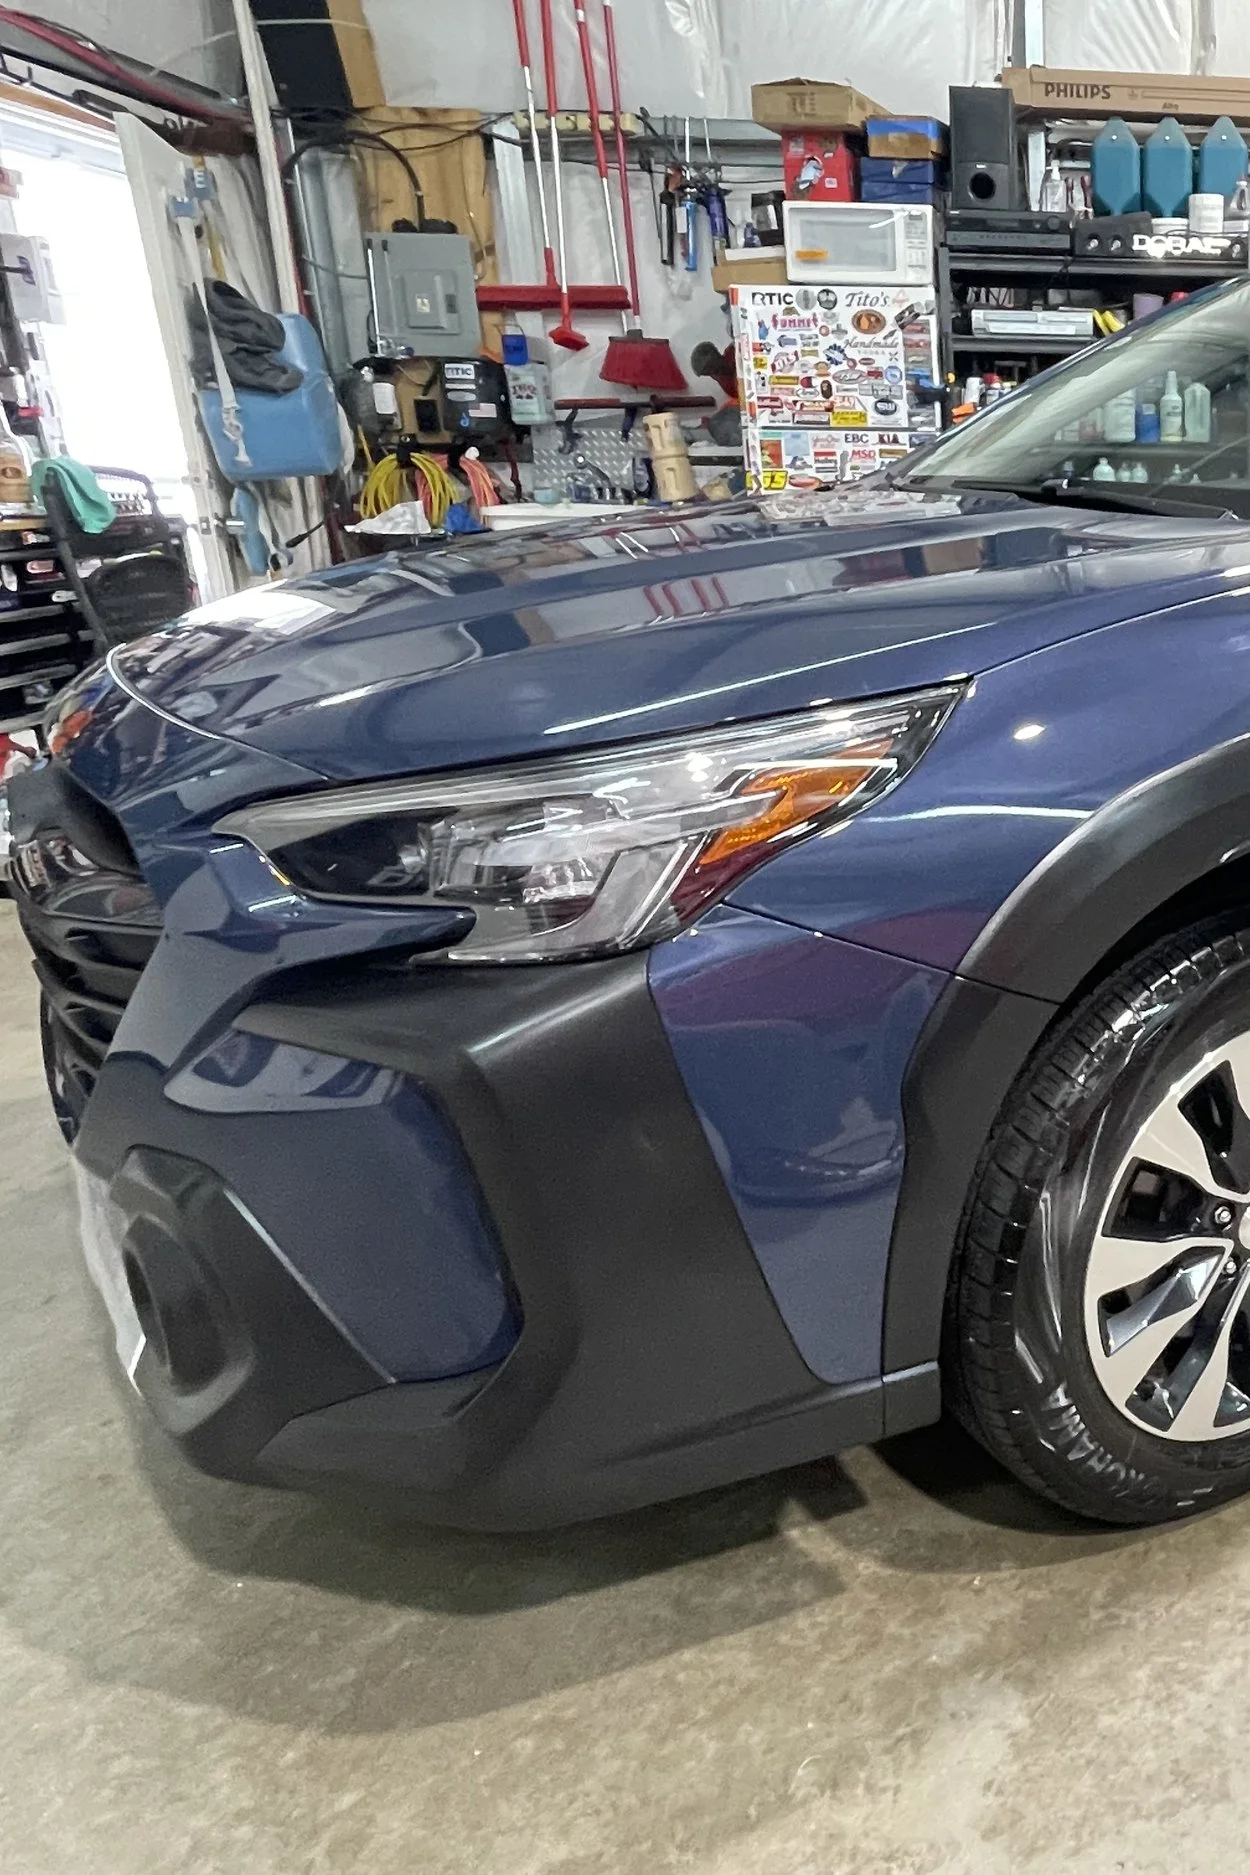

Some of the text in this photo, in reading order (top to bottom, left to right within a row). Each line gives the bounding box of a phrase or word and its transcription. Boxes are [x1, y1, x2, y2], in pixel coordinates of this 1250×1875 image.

[1044, 82, 1111, 100] PHILIPS
[751, 292, 794, 306] RTIC
[845, 290, 890, 307] Tito's
[845, 433, 869, 444] EBC
[878, 432, 900, 445] KIA
